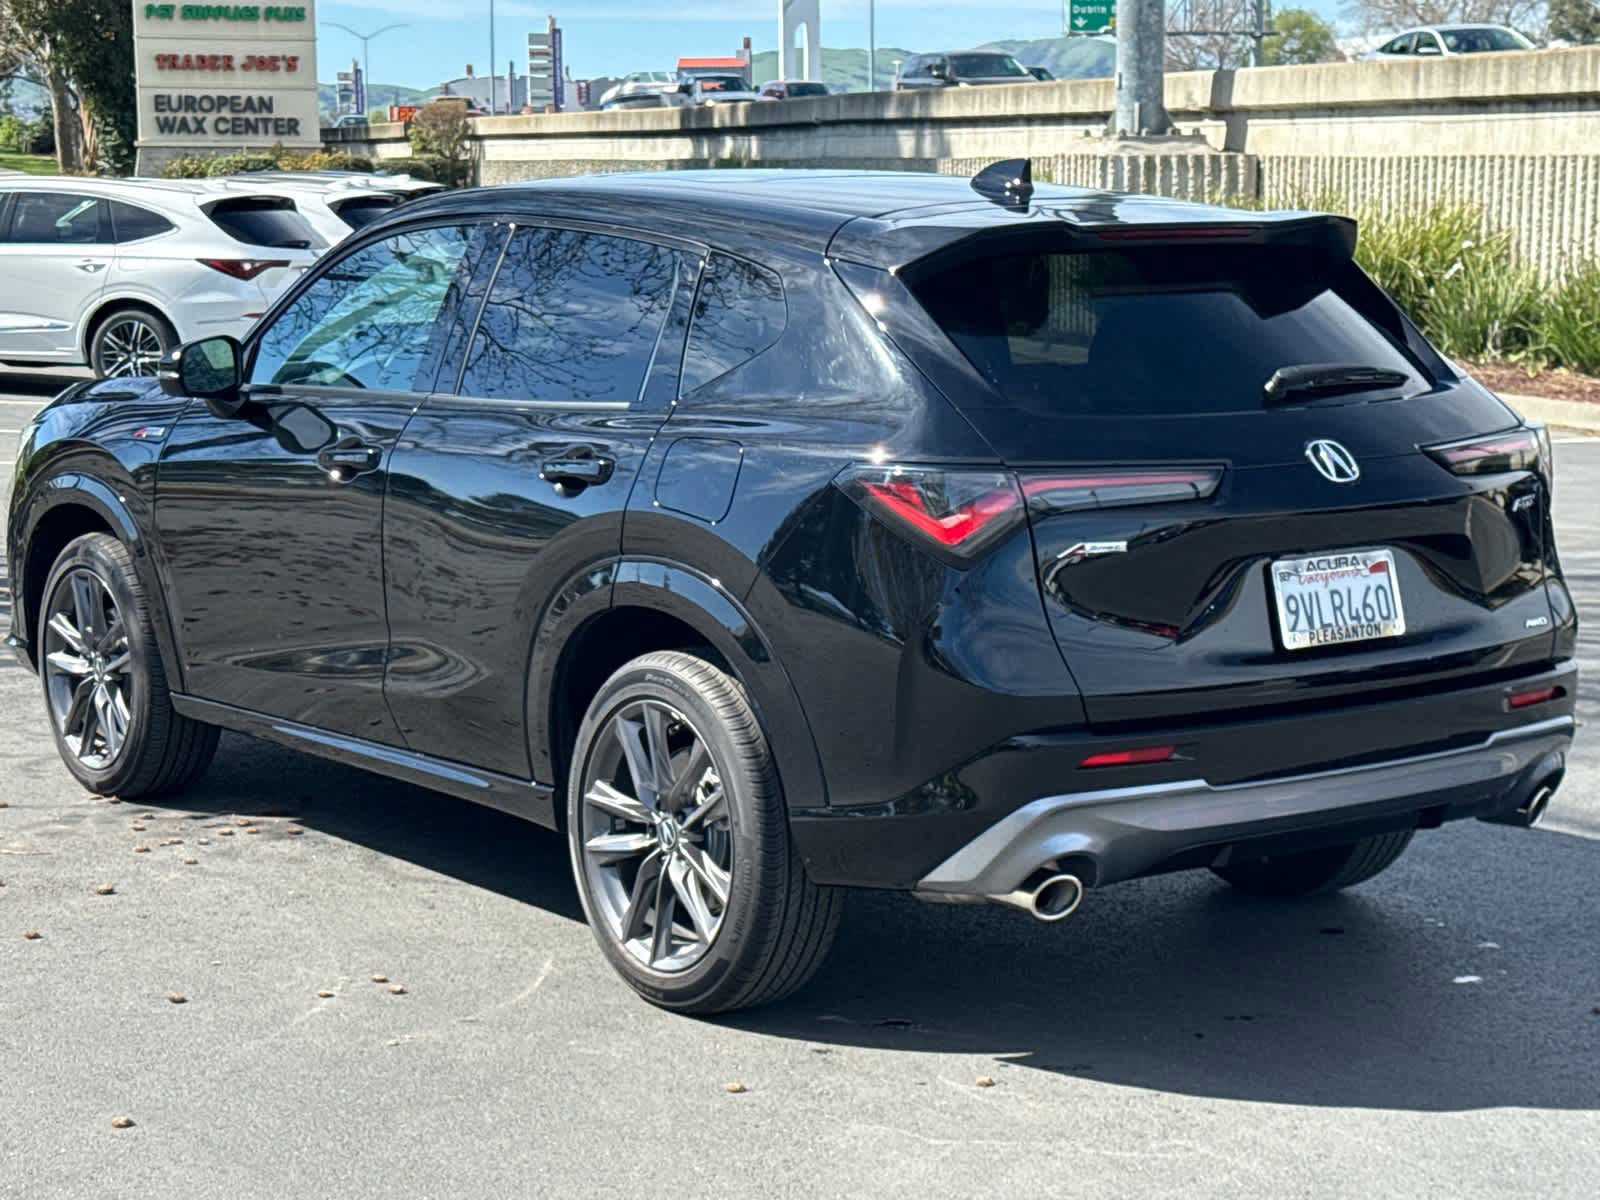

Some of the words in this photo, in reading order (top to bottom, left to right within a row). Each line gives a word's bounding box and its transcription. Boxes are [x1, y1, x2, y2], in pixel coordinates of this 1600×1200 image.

[144, 4, 175, 20] PET
[181, 4, 260, 21] SUPPLIES
[264, 6, 306, 22] PLUS
[1072, 4, 1107, 14] Dublin
[155, 53, 235, 72] TRADER
[241, 54, 300, 73] JOE'S
[154, 94, 274, 114] EUROPEAN
[155, 116, 207, 134] WAX
[214, 117, 301, 137] CENTER
[1306, 555, 1361, 572] ACURA
[1285, 584, 1392, 632] 9VLR460
[1308, 622, 1382, 645] PLEASANTON
